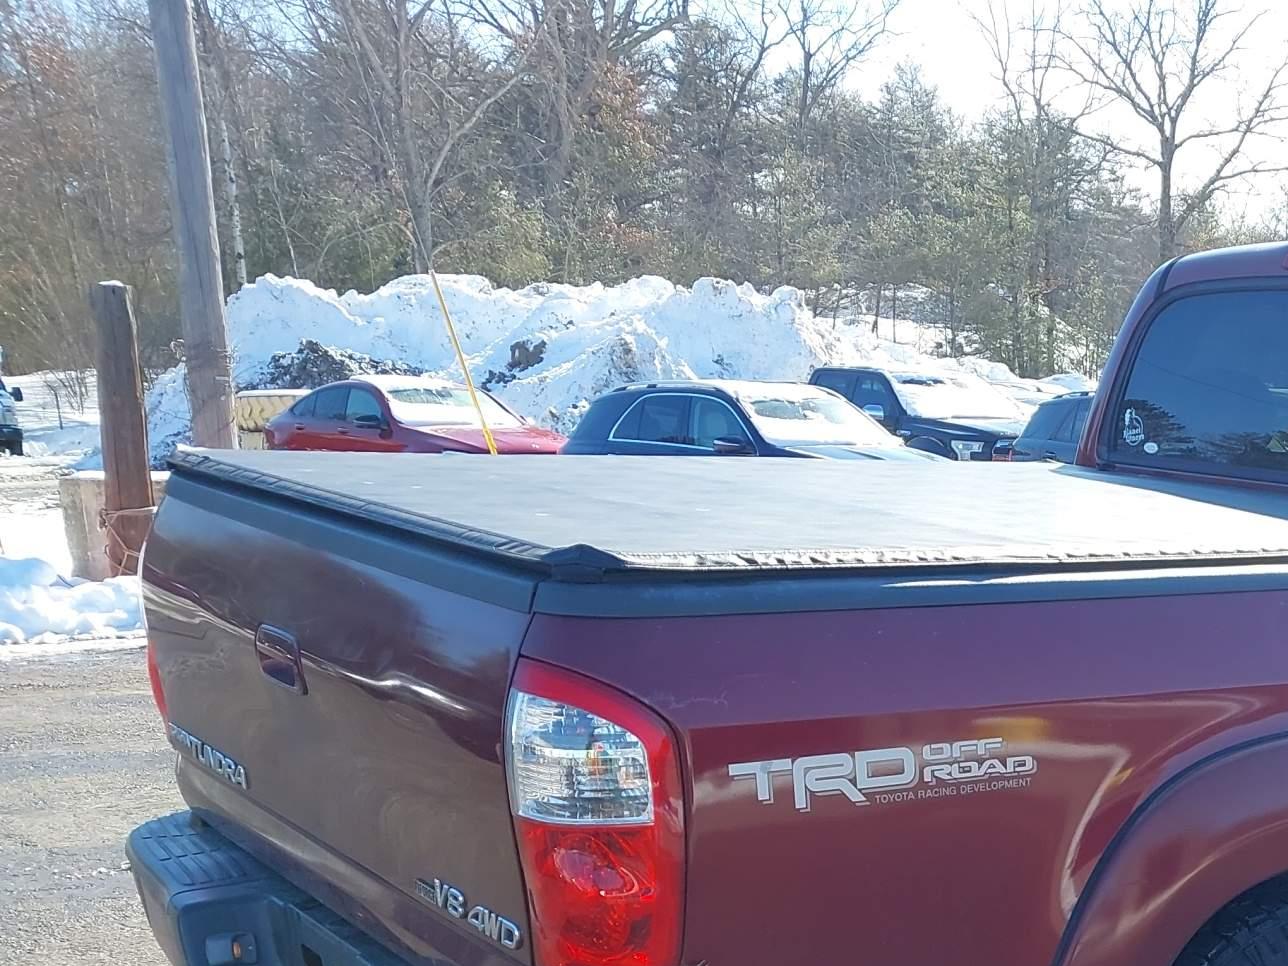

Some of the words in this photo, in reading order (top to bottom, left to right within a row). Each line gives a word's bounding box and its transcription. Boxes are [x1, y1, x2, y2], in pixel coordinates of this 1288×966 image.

[188, 733, 247, 790] TUNDRA
[922, 737, 1004, 762] OFF
[923, 755, 1037, 784] ROAD
[728, 746, 918, 812] TRD
[875, 790, 915, 804] TOYOTA
[917, 786, 957, 800] RACING
[960, 777, 1032, 794] DEVELOPMENT
[434, 878, 465, 918] V8
[467, 905, 520, 950] 4WD
